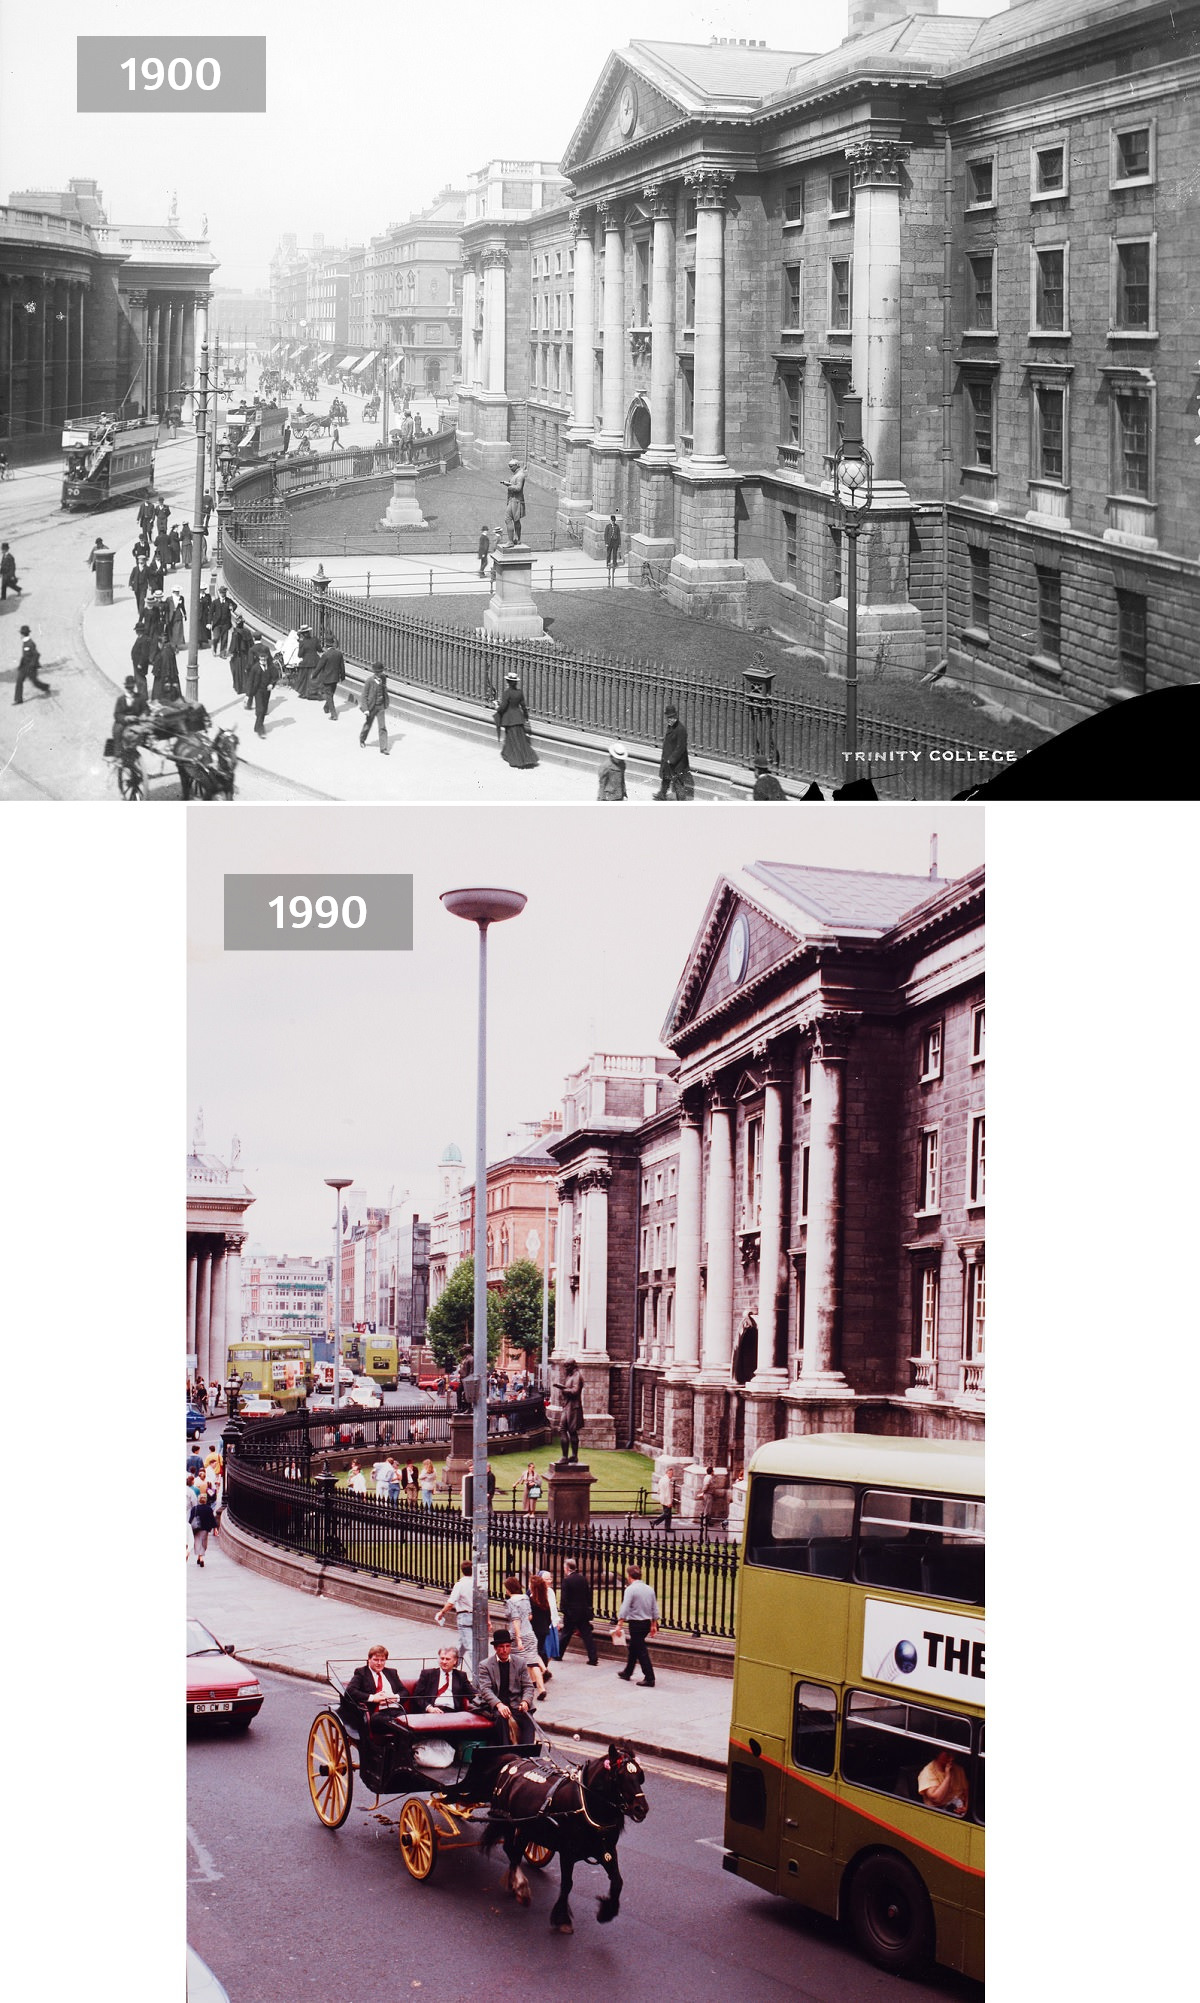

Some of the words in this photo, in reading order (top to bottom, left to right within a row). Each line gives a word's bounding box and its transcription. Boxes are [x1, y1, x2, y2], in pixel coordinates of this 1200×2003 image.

[67, 488, 80, 496] 70
[923, 1631, 985, 1680] THE
[196, 1704, 206, 1712] 90
